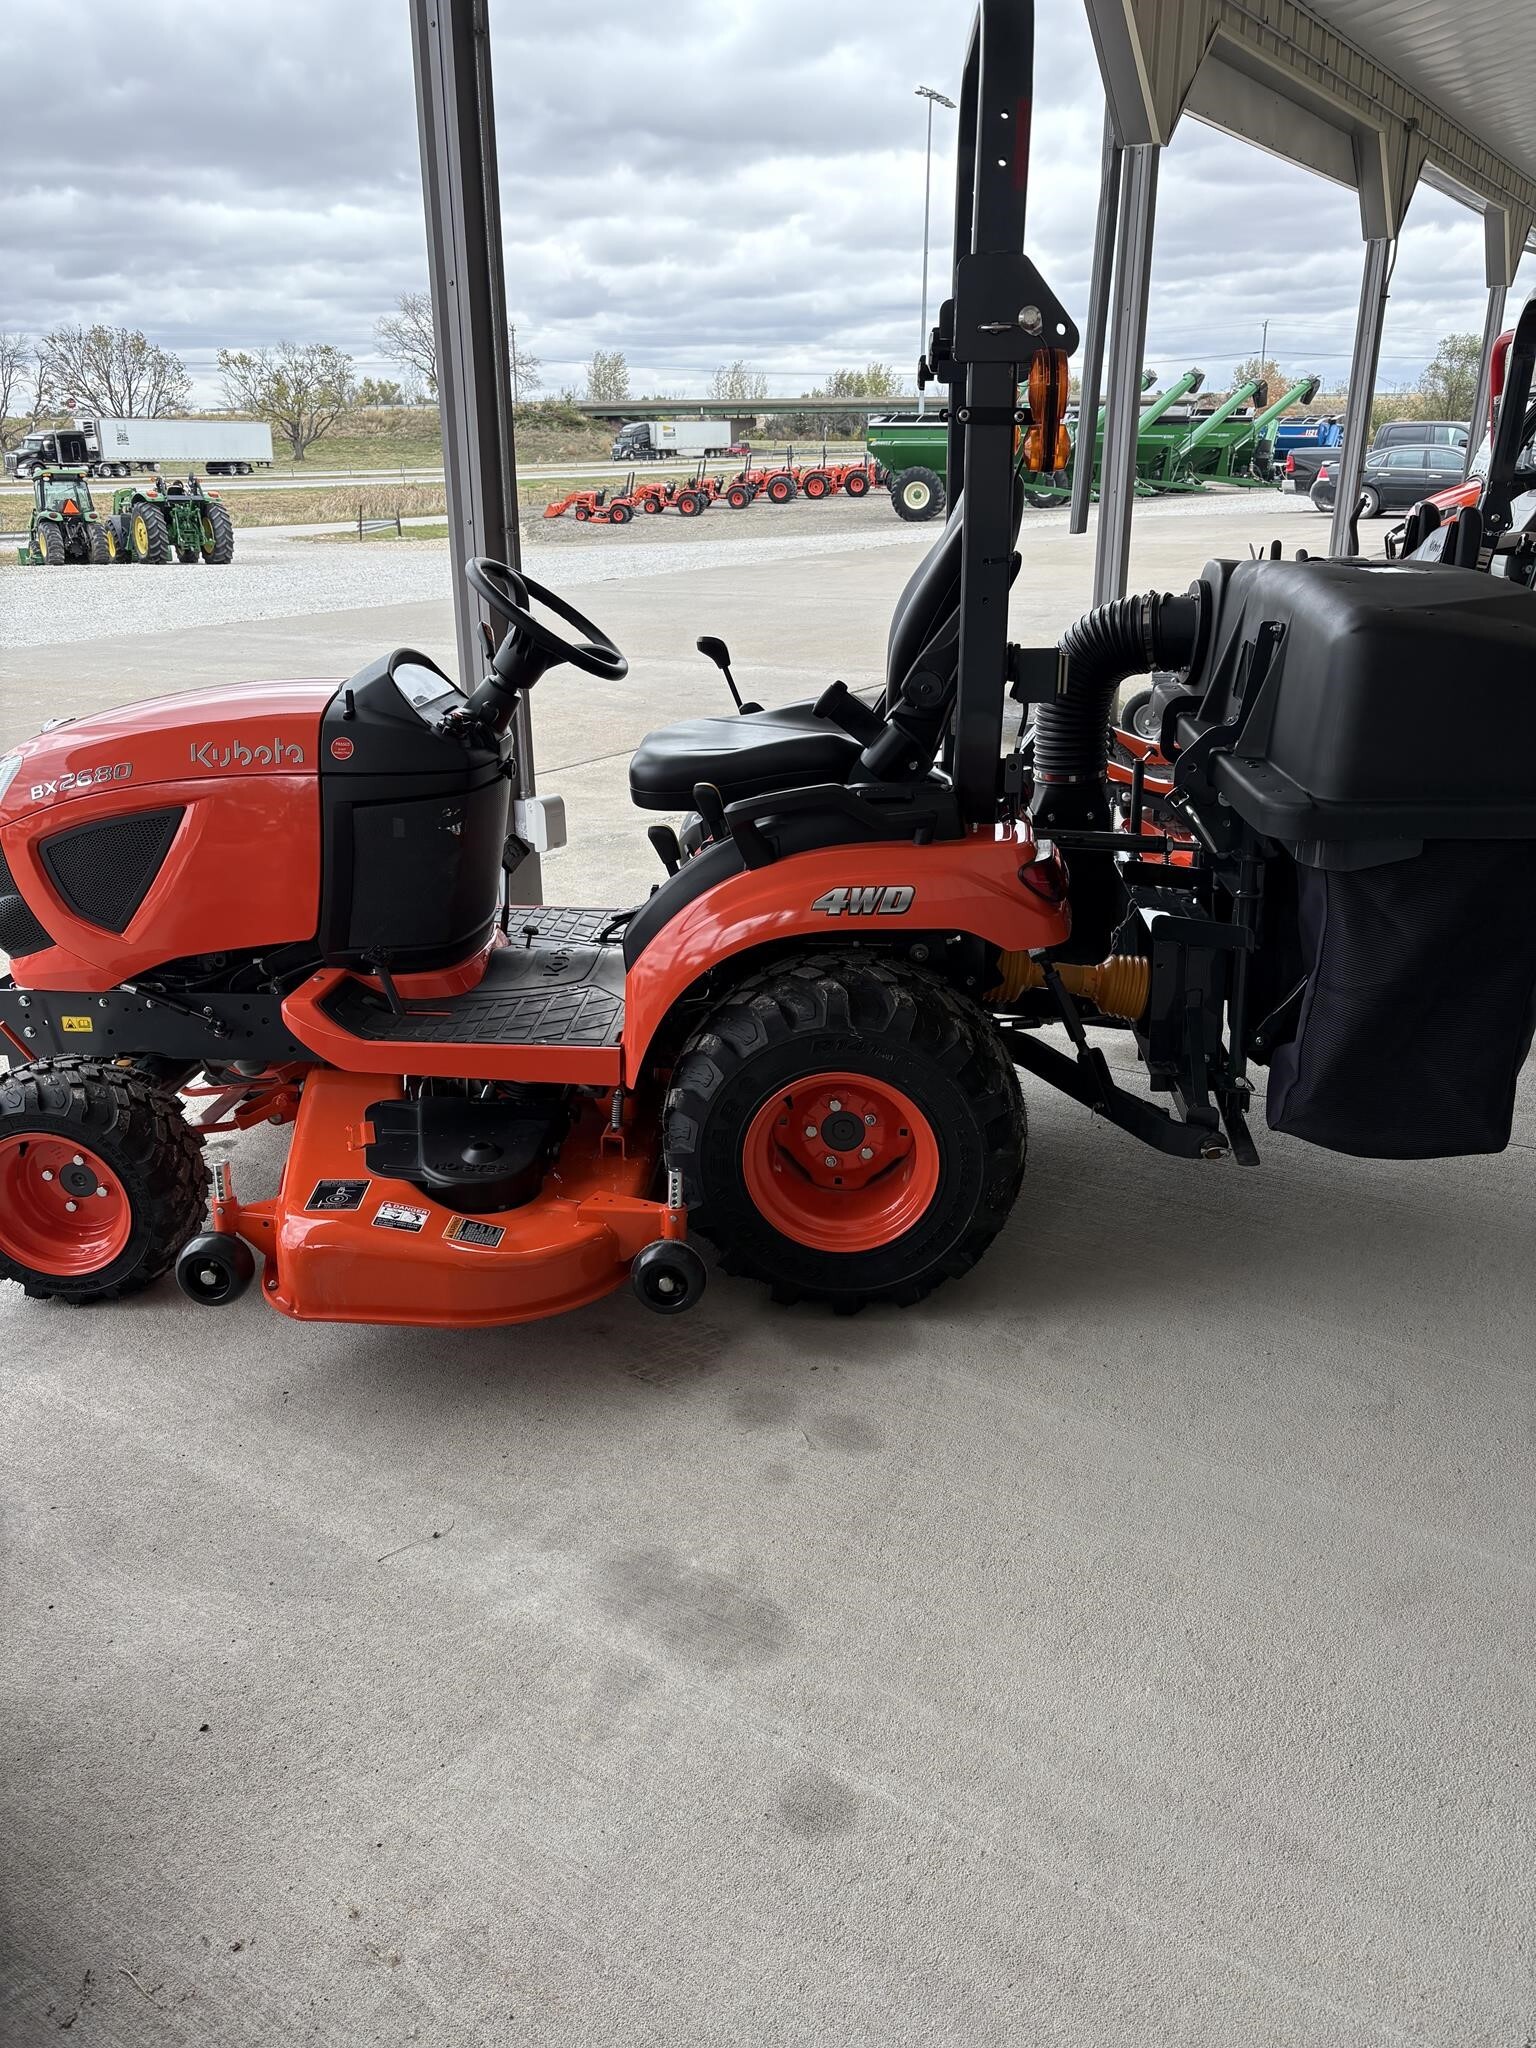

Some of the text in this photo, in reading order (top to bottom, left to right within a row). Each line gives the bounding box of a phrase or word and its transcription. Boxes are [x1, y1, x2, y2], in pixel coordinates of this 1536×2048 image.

[190, 737, 304, 767] Kubota
[30, 763, 132, 800] BX2680
[811, 886, 915, 916] 4WD
[393, 1204, 428, 1214] DANGER
